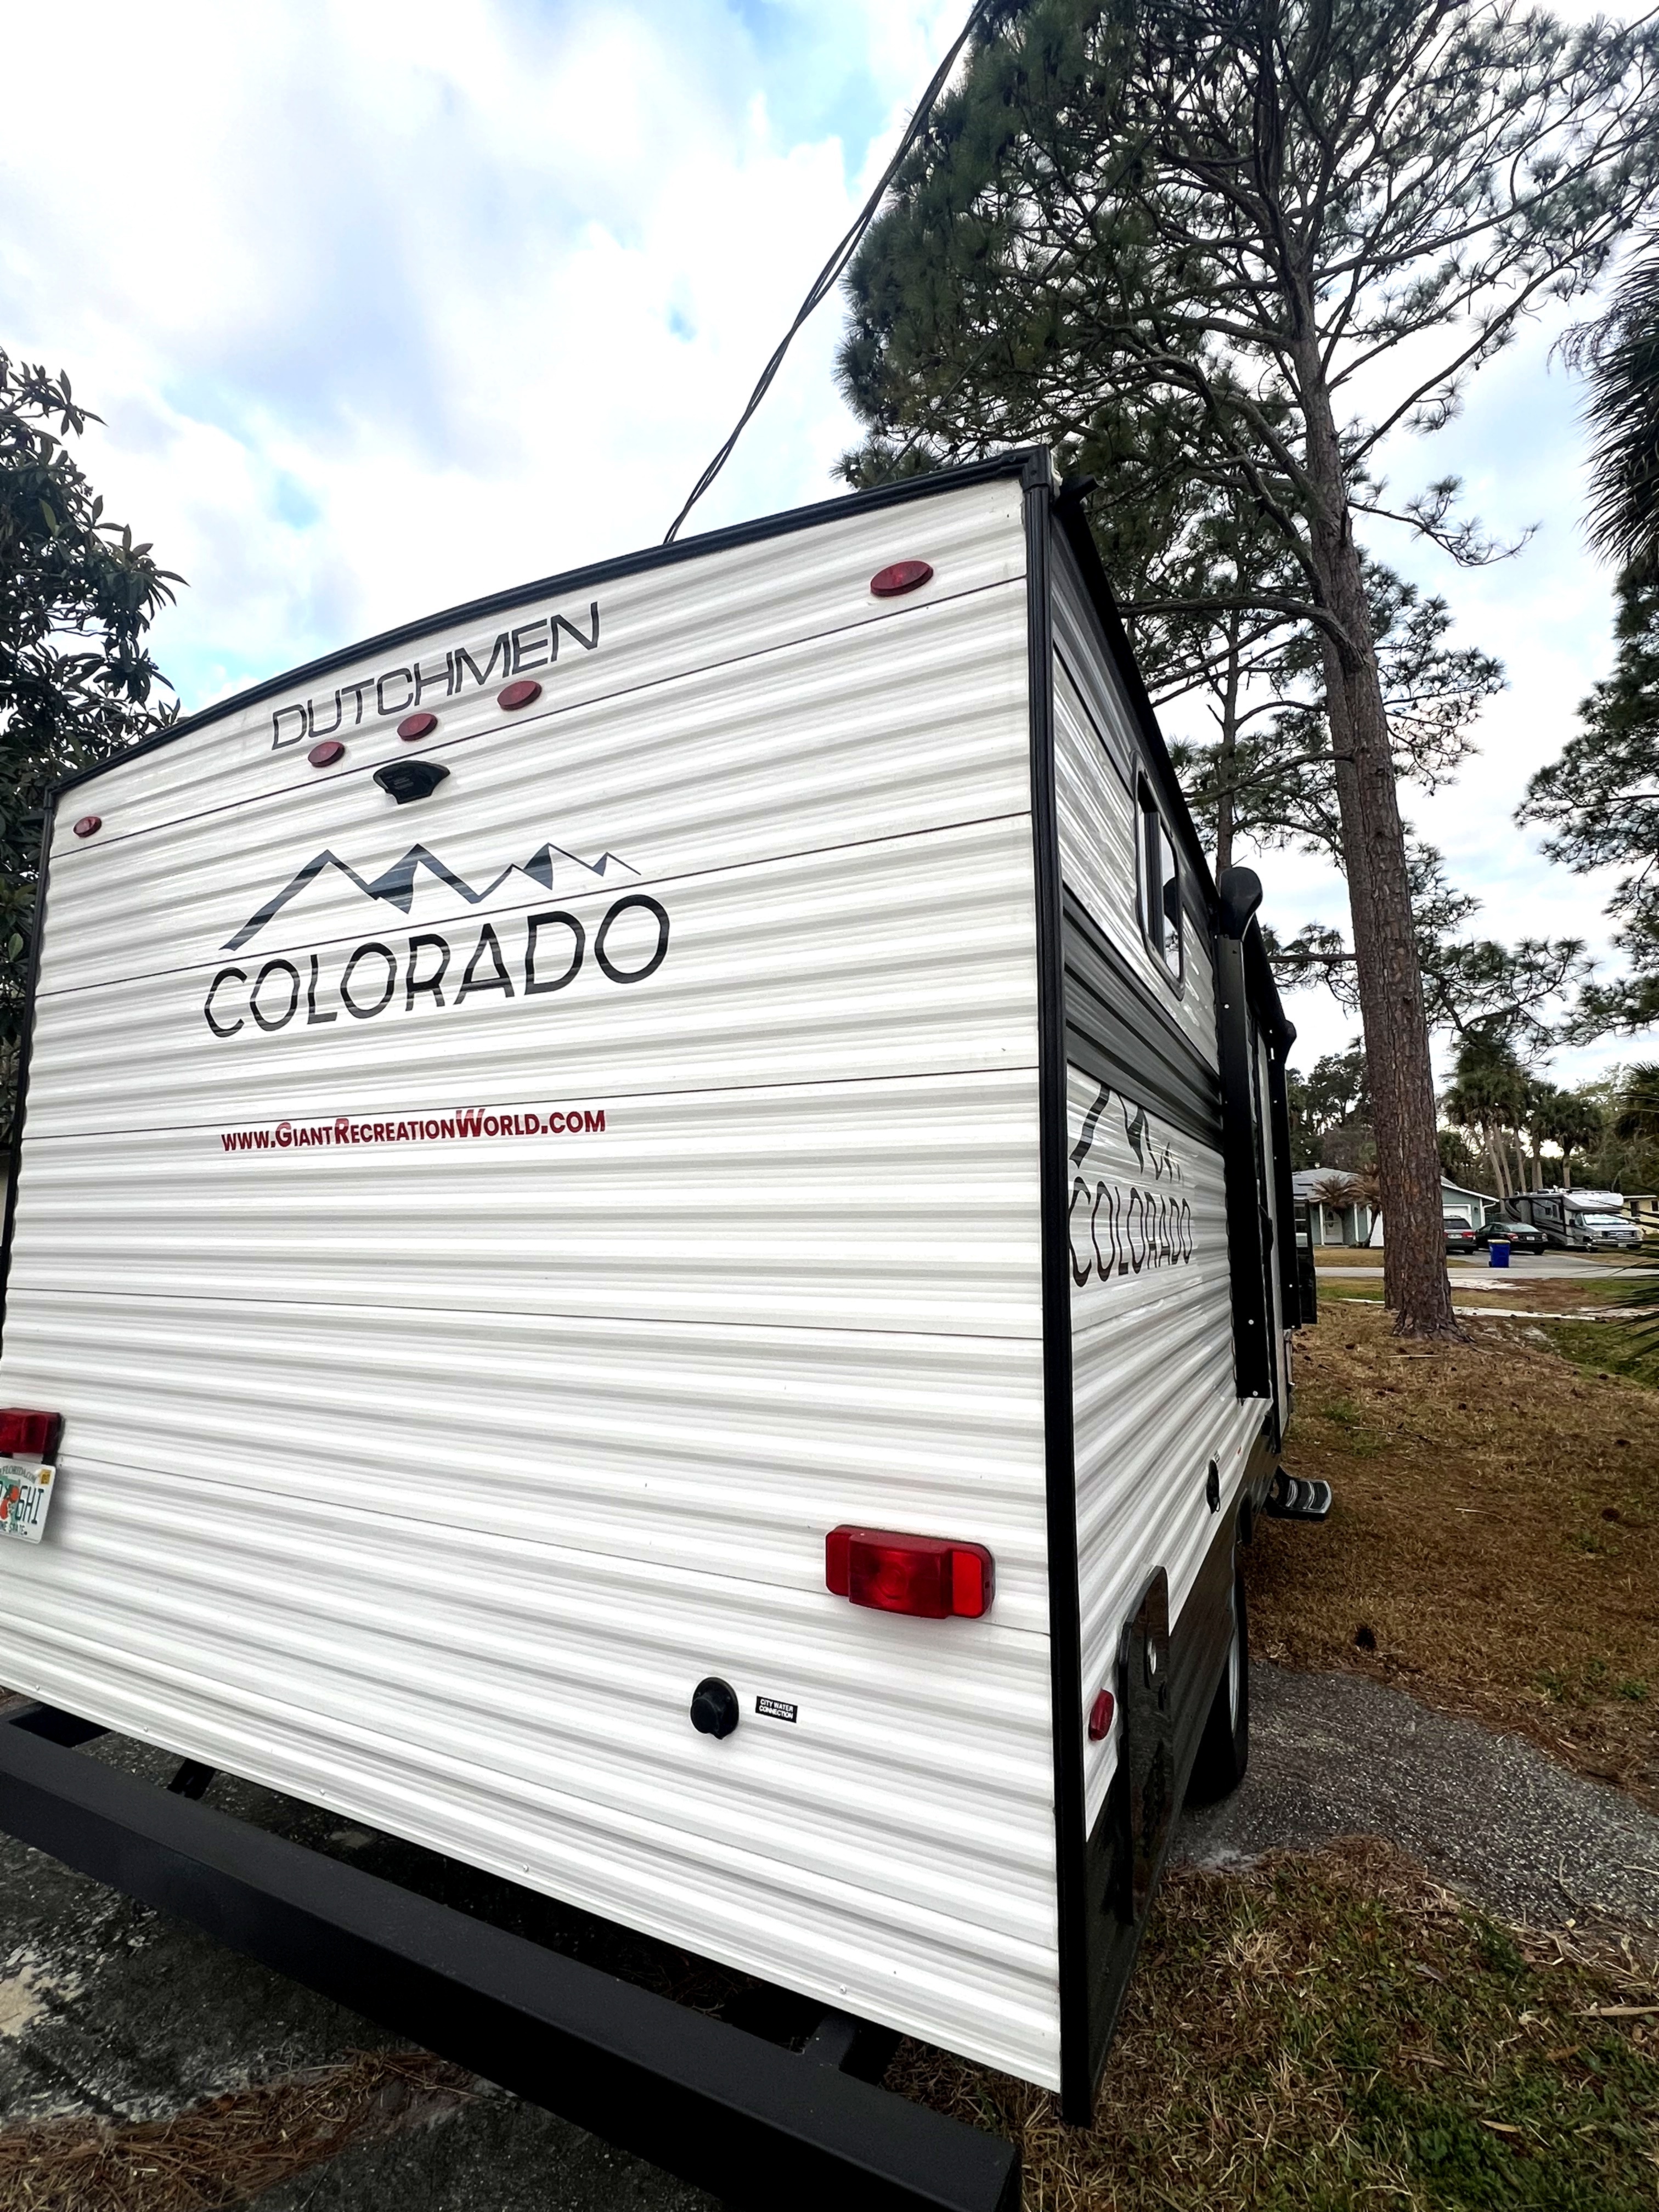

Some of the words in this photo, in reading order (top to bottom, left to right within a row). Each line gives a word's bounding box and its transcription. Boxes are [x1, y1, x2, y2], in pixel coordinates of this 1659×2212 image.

[271, 601, 600, 750] DUTCHMEN
[204, 894, 670, 1037] COLORADO
[1069, 1176, 1193, 1288] COLORADO
[759, 1705, 793, 1719] CONNECTION
[760, 1699, 773, 1707] CITY
[774, 1702, 793, 1712] WATER
